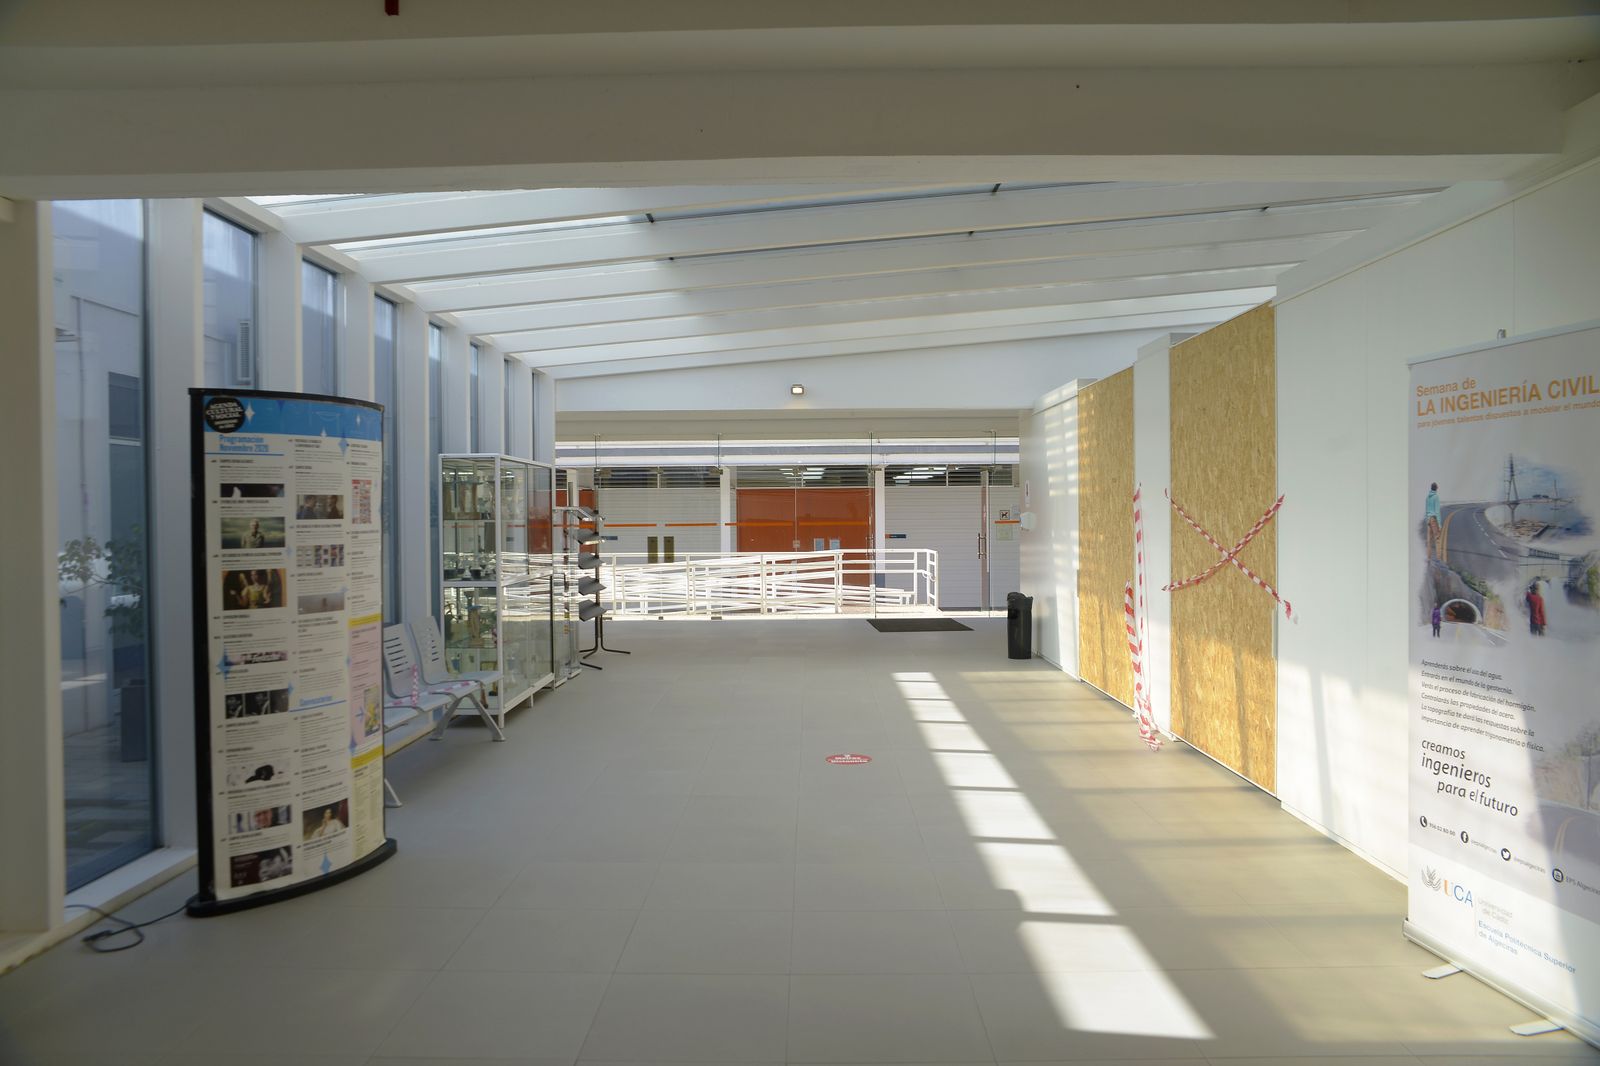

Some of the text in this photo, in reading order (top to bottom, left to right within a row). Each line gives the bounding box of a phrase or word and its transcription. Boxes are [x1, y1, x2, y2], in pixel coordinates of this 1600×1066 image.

[1416, 377, 1476, 397] Semana de
[1417, 375, 1600, 416] LA INGENIERÍA CIVIL
[1449, 665, 1466, 673] sobre
[1439, 687, 1461, 695] proceso
[1510, 726, 1528, 735] sobre
[1421, 739, 1466, 760] creamos
[1421, 752, 1491, 788] ingenieros
[1436, 780, 1518, 817] para el futuro
[1444, 879, 1474, 908] UCA
[1478, 919, 1504, 938] Escuela
[1543, 951, 1577, 975] Superior
[1488, 934, 1518, 955] Algeciras
